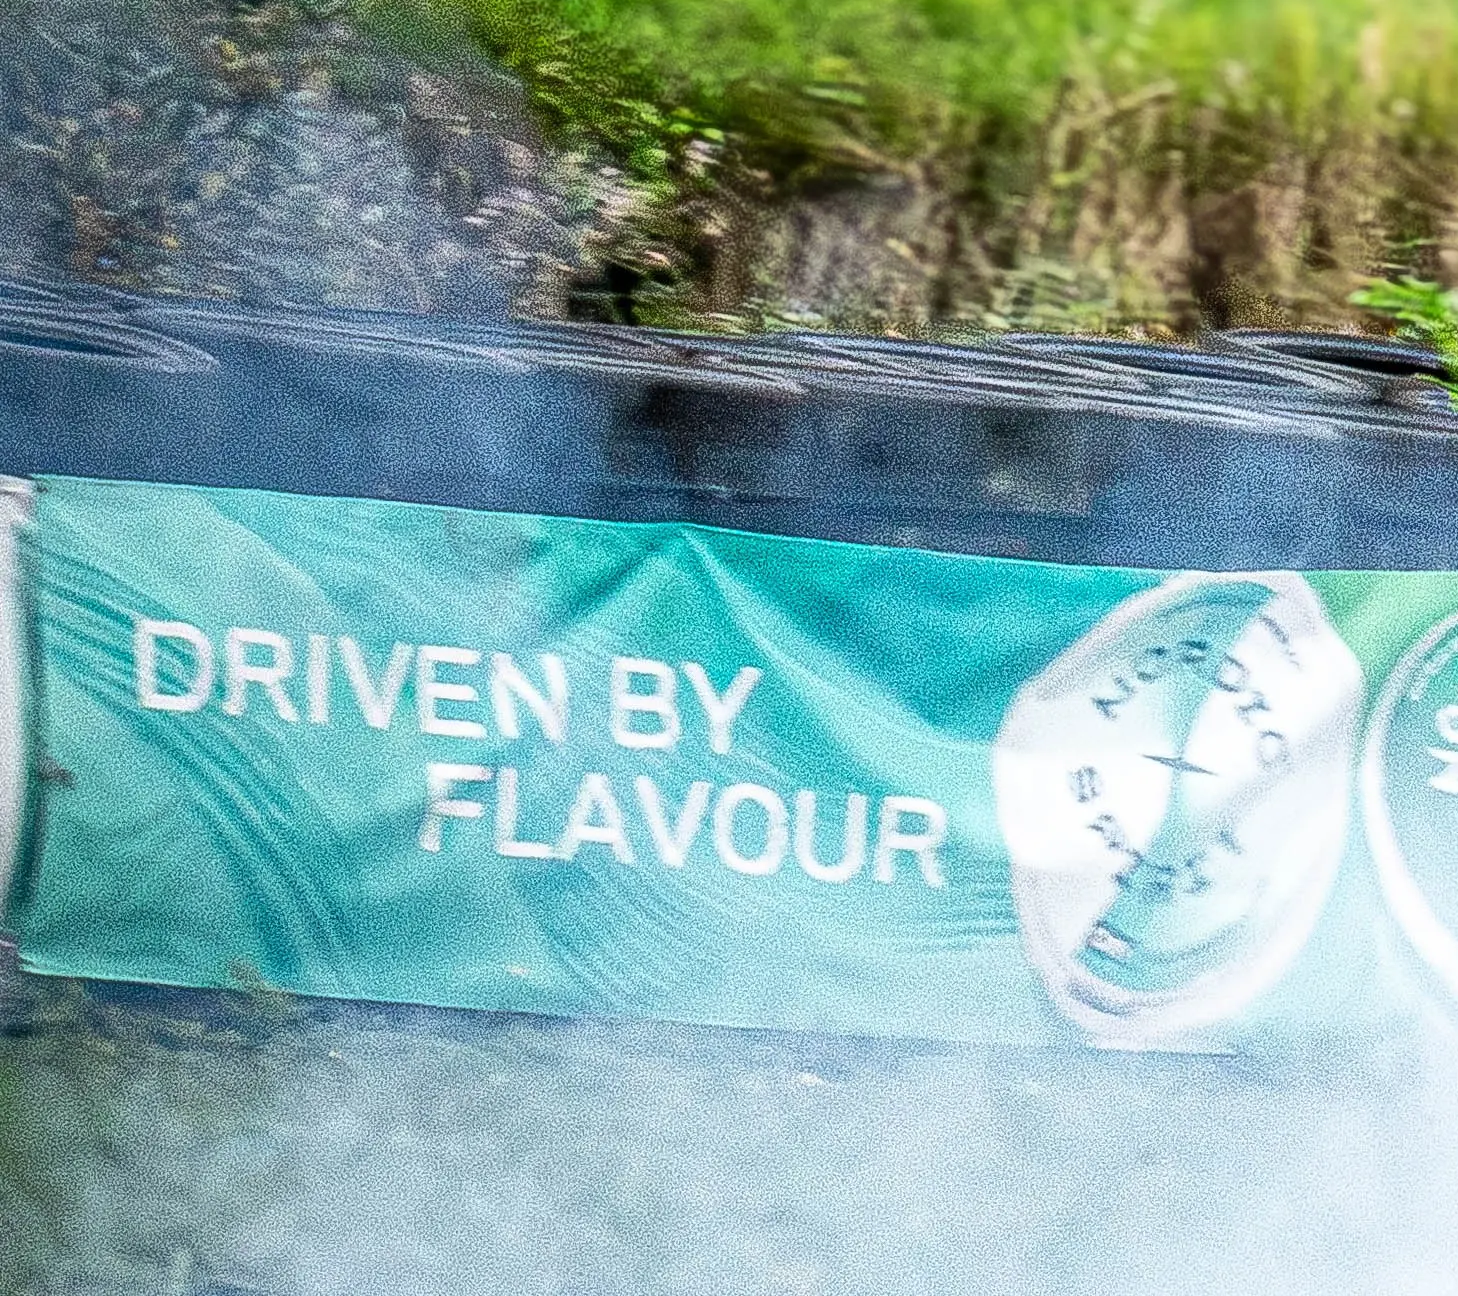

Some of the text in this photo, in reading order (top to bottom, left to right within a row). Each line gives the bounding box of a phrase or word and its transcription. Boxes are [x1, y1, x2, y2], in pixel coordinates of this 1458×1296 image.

[131, 618, 763, 756] DRIVEN BY
[418, 760, 949, 888] FLAVOUR
